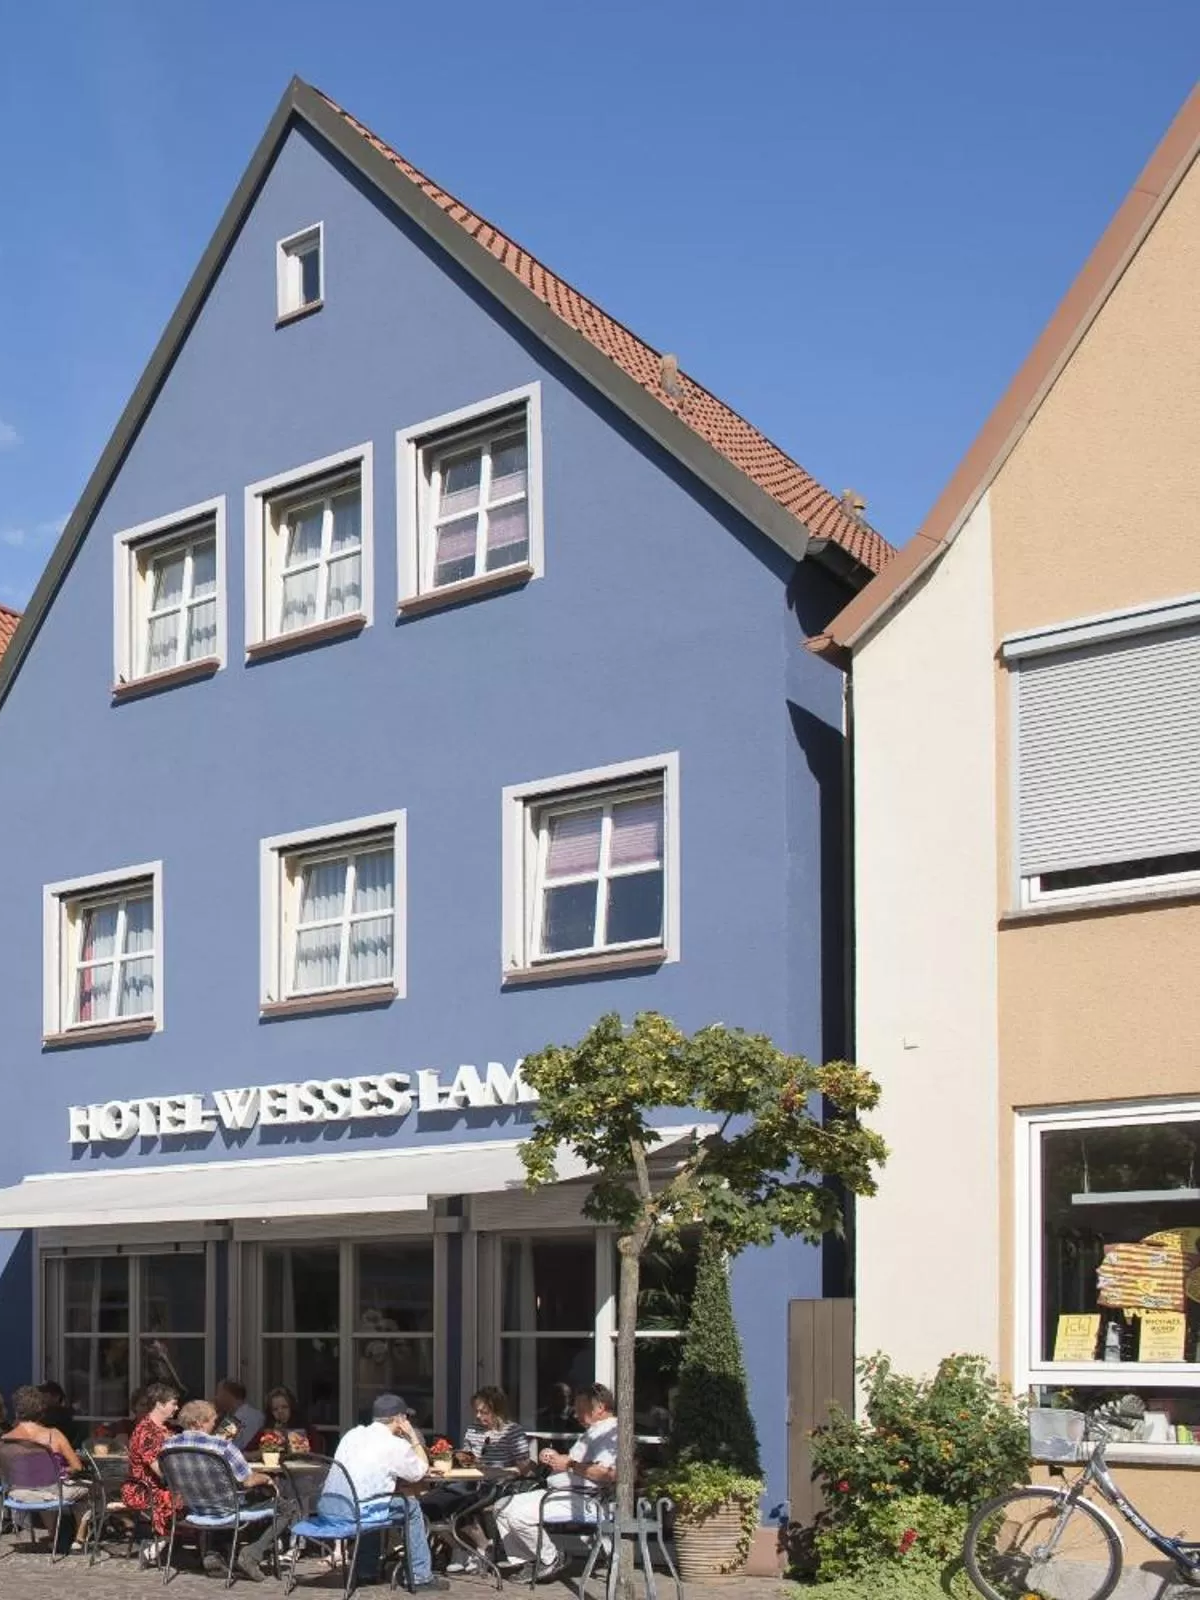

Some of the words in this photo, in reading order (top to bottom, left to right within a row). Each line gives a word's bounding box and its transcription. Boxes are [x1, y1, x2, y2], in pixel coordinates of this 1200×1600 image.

[68, 1093, 217, 1144] HOTEL
[212, 1072, 411, 1131] WEISSES
[416, 1058, 540, 1112] LAM
